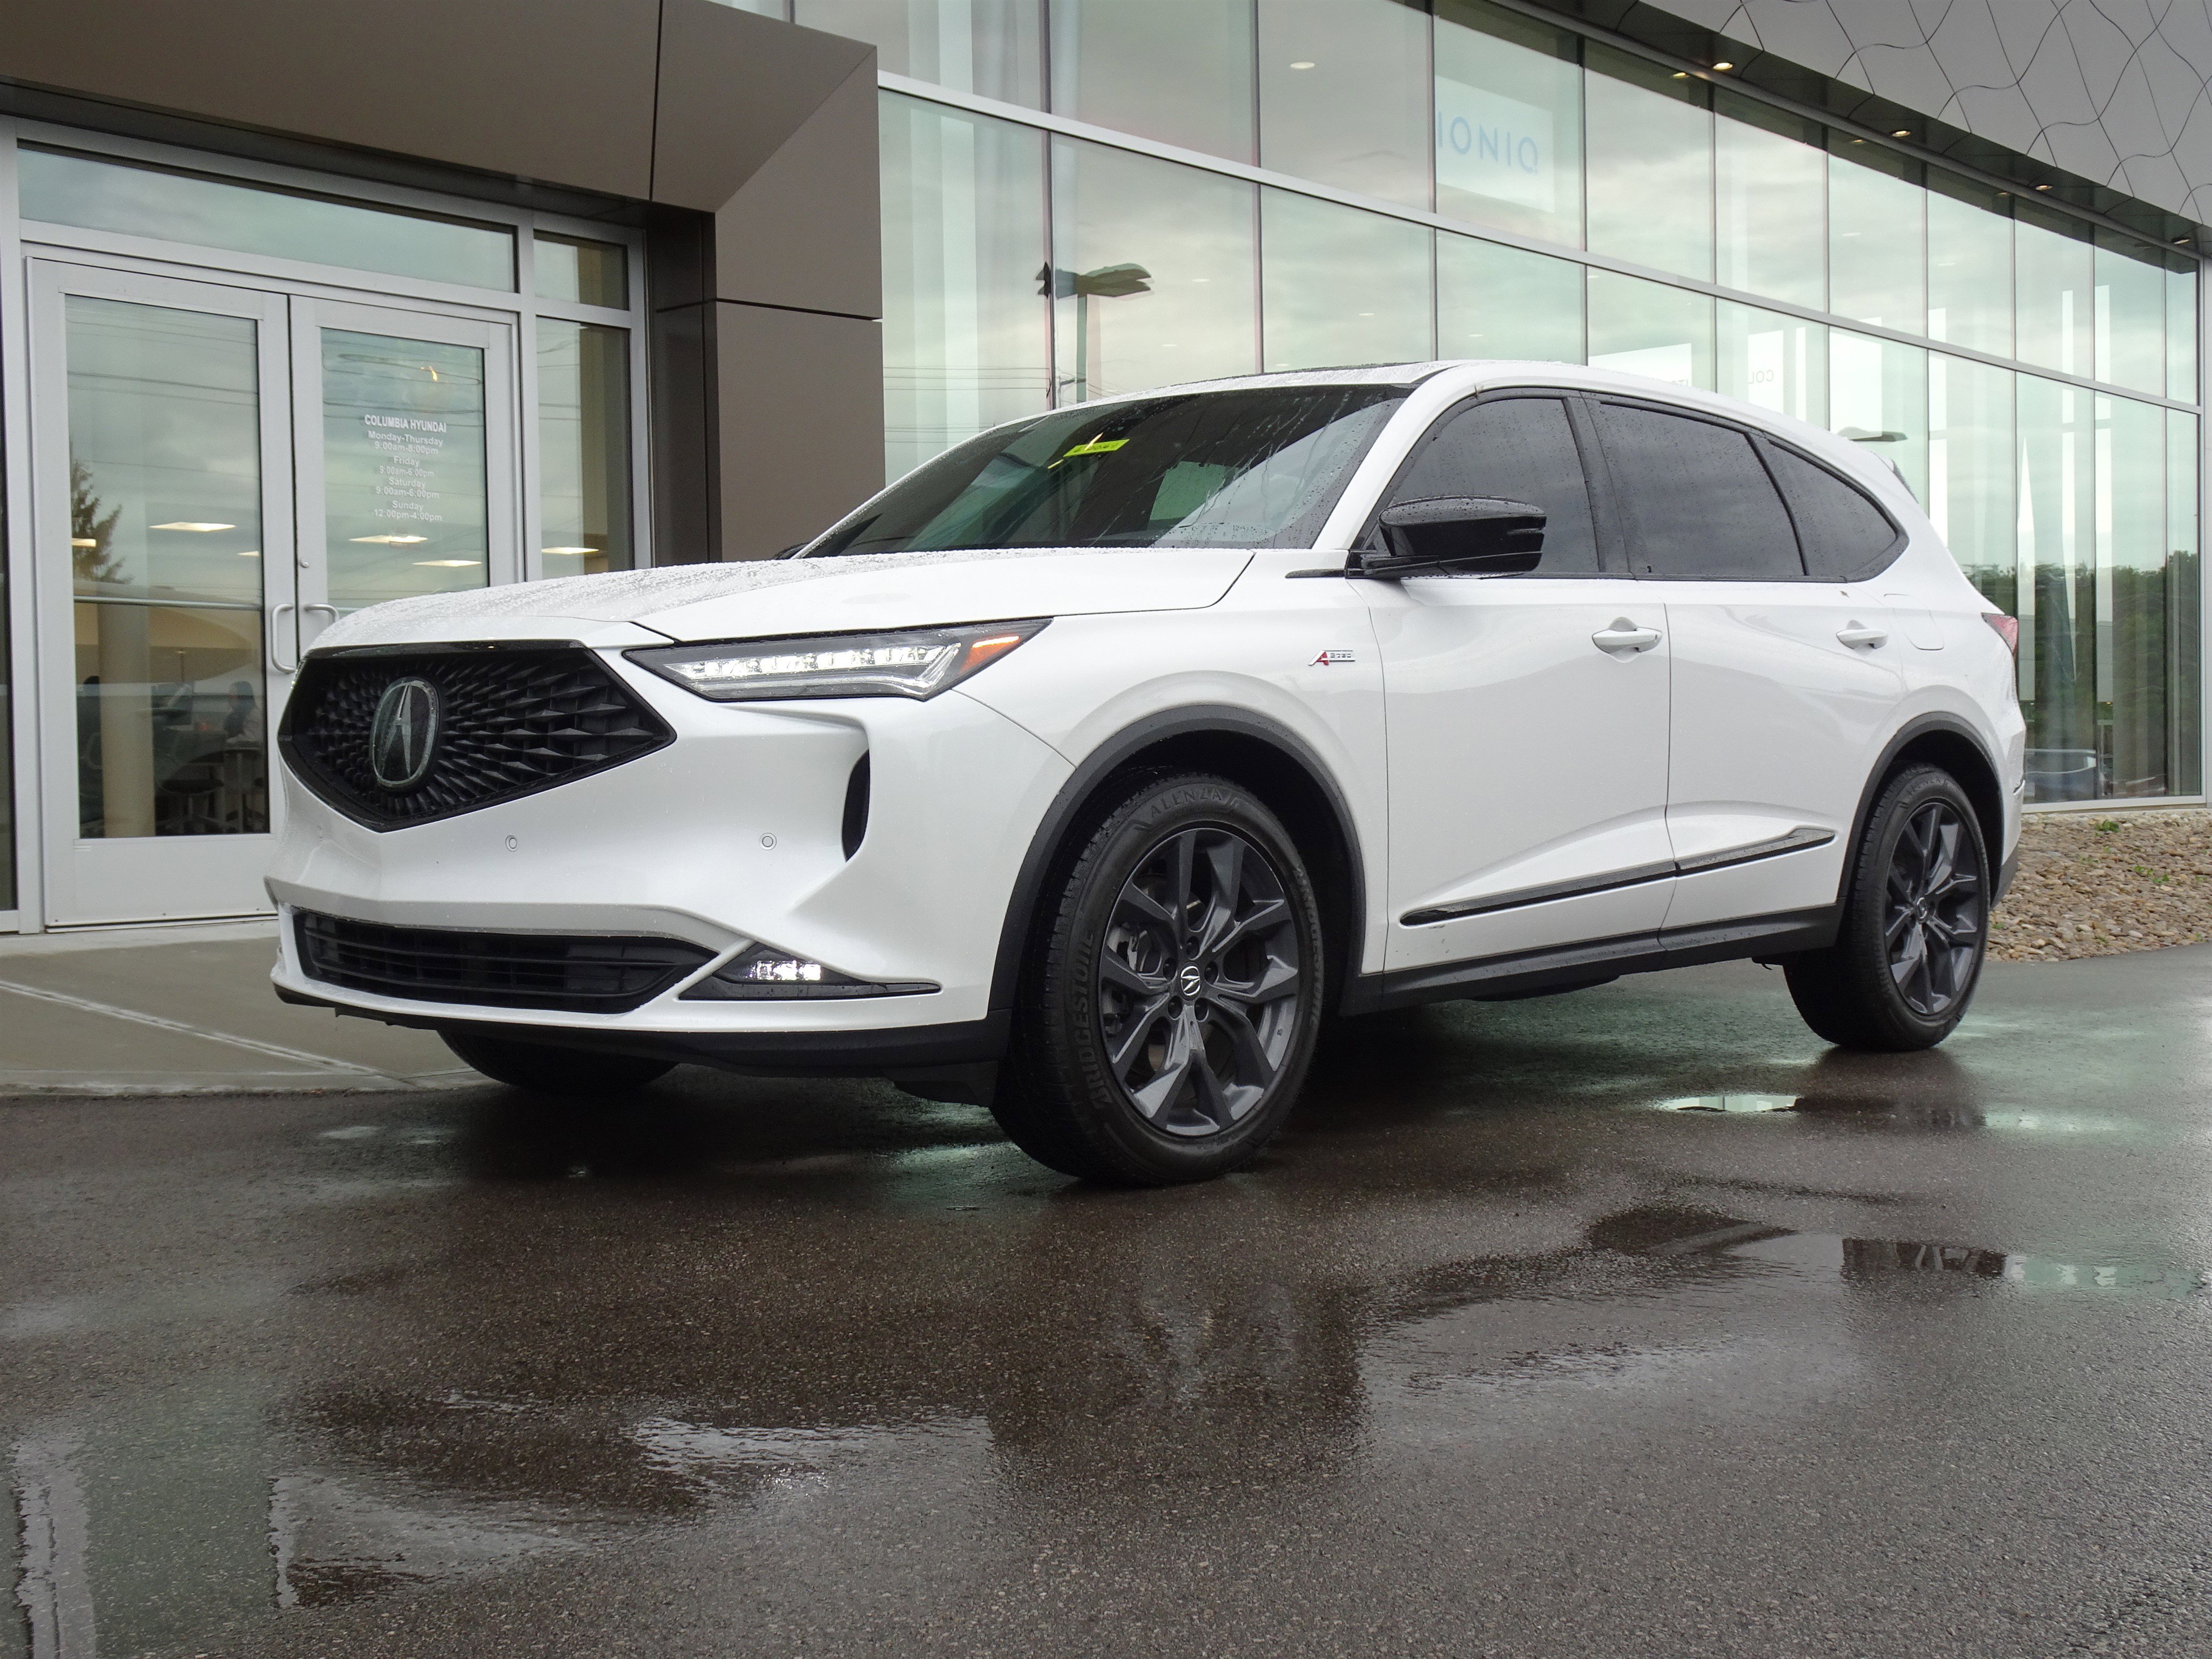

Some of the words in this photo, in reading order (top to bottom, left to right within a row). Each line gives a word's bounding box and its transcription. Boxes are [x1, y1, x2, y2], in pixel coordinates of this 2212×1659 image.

[1437, 111, 1538, 174] IONIQ
[365, 414, 409, 429] COLUMBIA
[410, 419, 447, 433] HYUNDAI
[368, 430, 443, 447] Monday-Thursday
[394, 455, 420, 467] Friday
[389, 476, 426, 490] Saturday
[393, 500, 424, 512] Sunday
